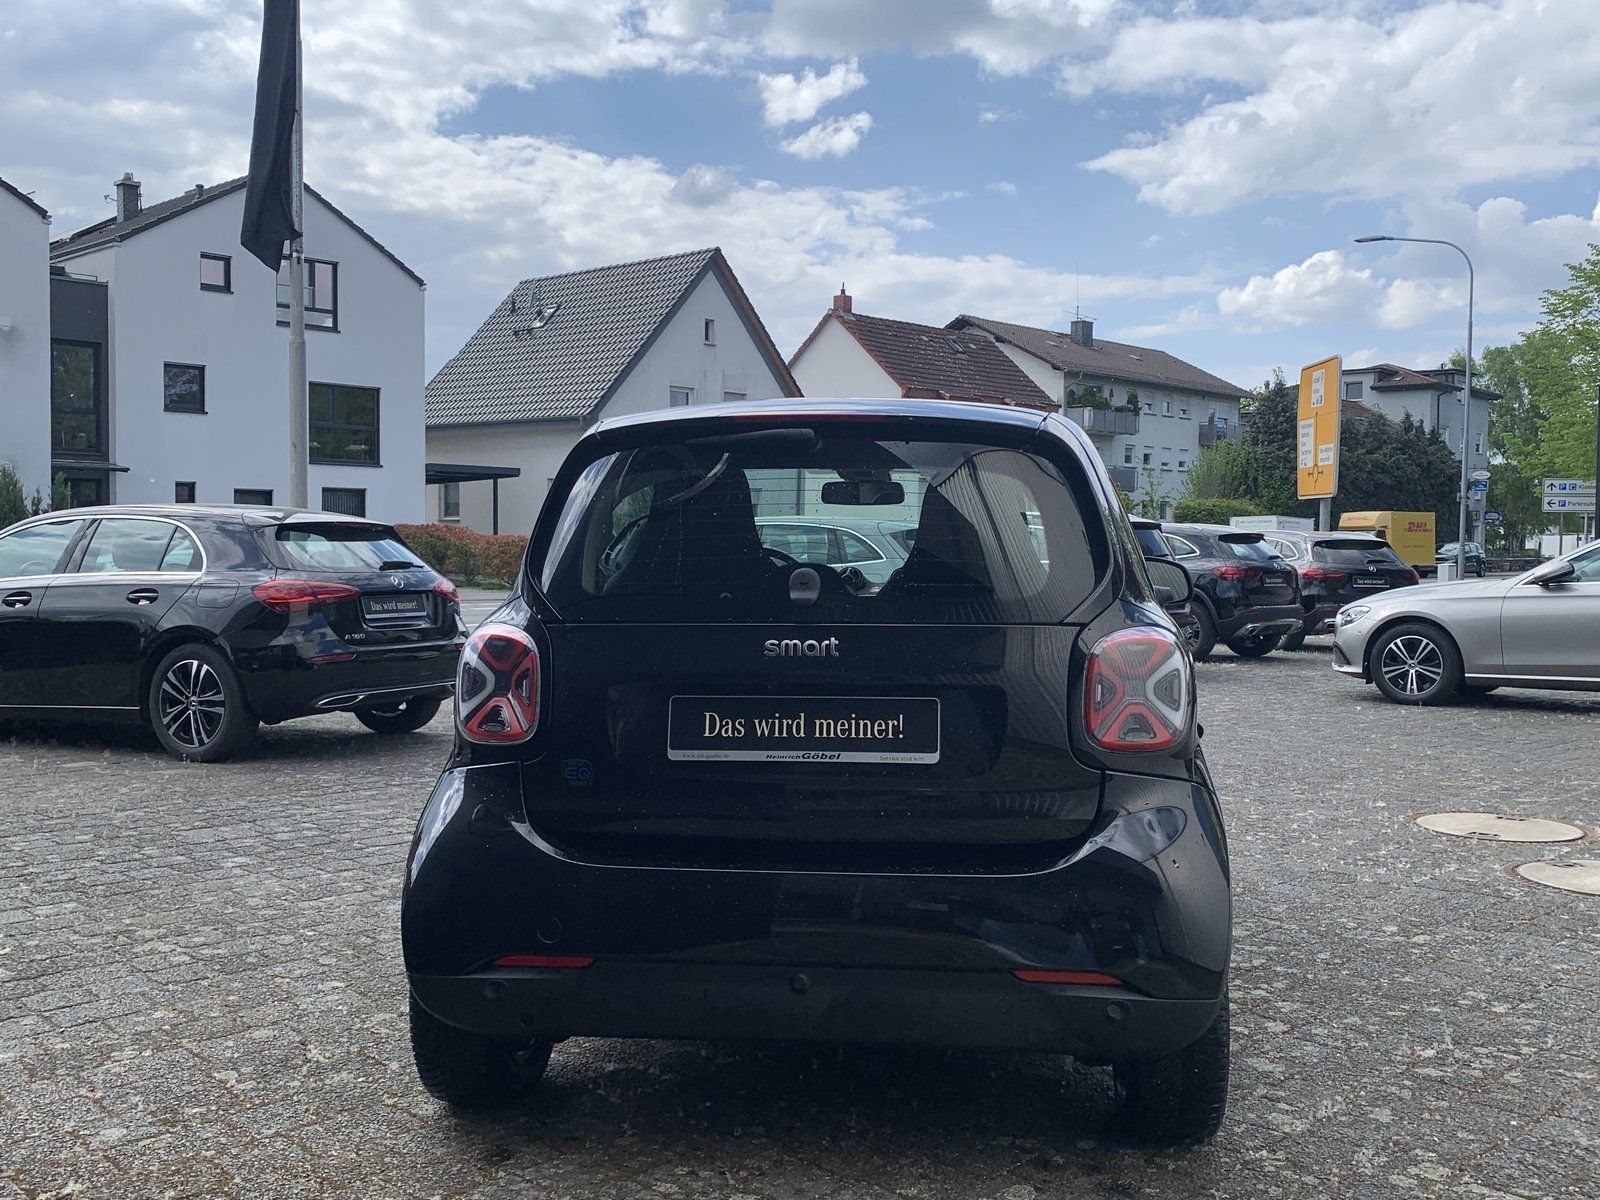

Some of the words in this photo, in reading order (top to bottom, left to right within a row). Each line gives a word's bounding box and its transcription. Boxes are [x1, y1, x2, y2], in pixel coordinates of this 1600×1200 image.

[370, 601, 382, 611] Das
[382, 600, 396, 610] wird
[396, 600, 418, 610] meiner!
[763, 637, 839, 656] smart
[703, 712, 745, 738] Das
[753, 712, 805, 738] wird
[814, 713, 904, 739] meiner!
[801, 752, 841, 760] Göbel
[565, 766, 590, 780] EQ
